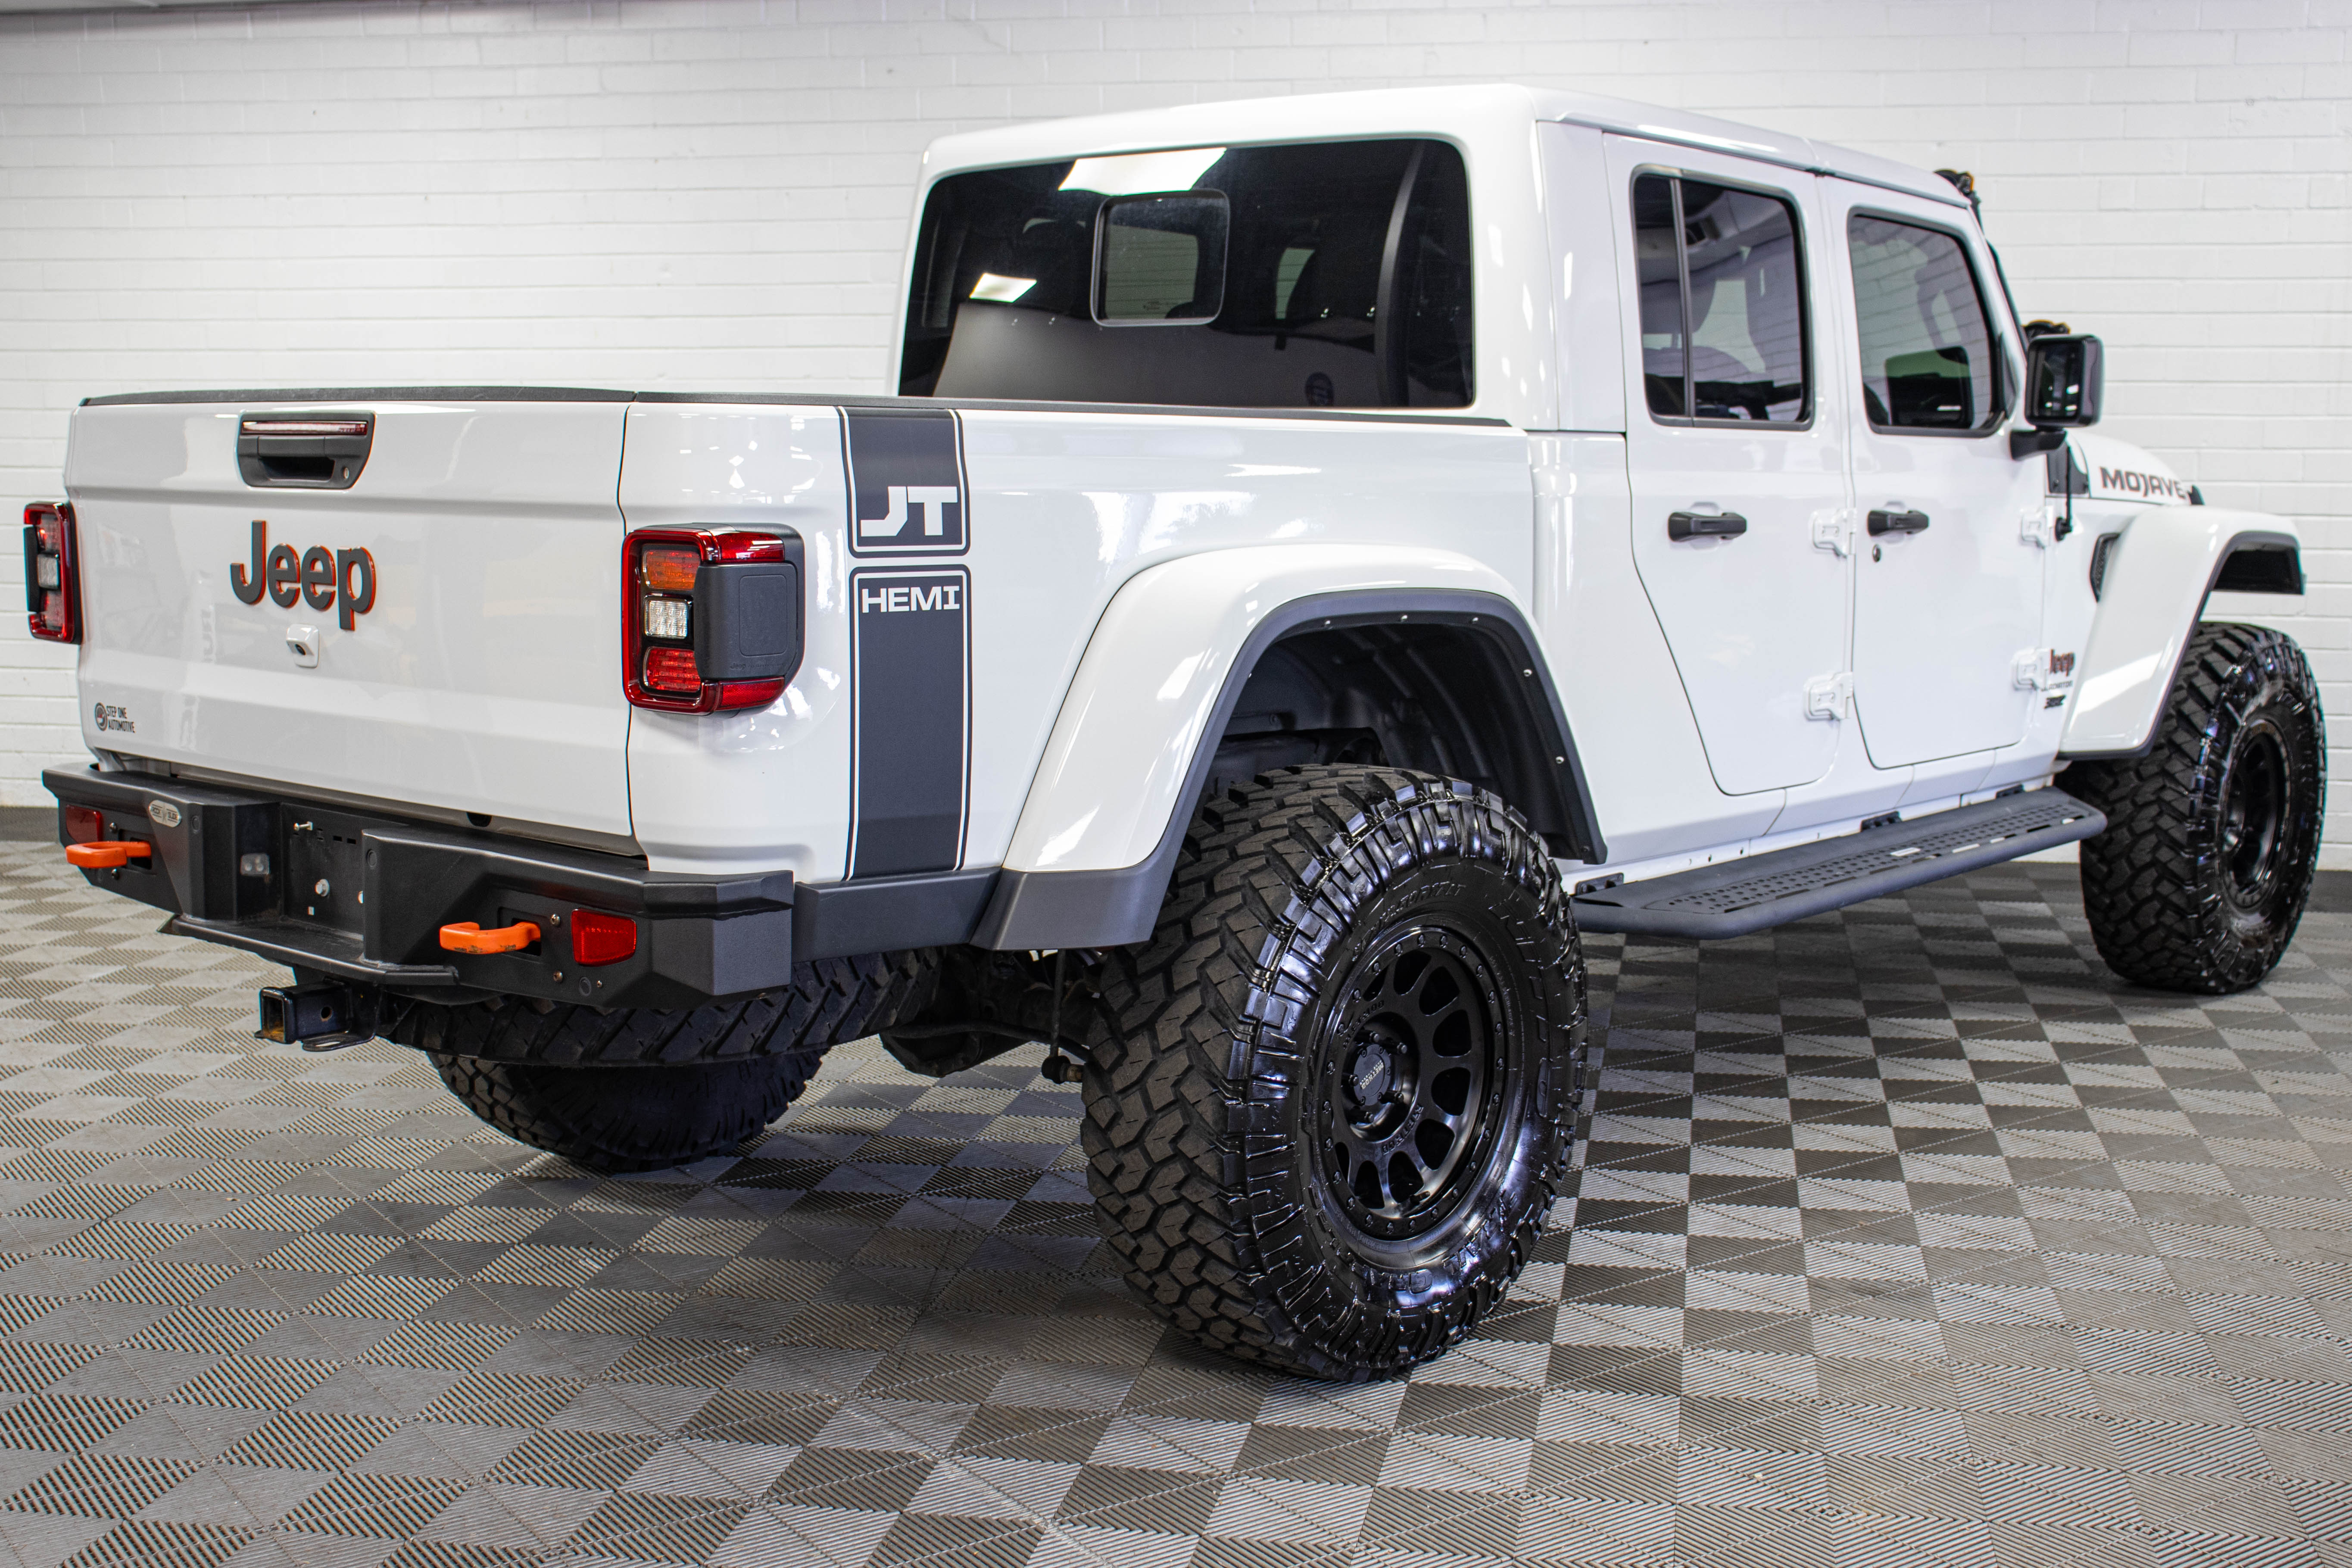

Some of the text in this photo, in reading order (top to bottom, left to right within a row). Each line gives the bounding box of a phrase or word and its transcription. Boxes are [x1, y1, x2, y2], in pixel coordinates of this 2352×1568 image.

[2099, 466, 2186, 499] MOJAVE
[861, 486, 958, 537] JT
[230, 520, 377, 631] Jeep
[862, 586, 960, 613] HEMI
[106, 706, 127, 719] STEP ONE
[108, 719, 135, 733] AUTOMOTIVE
[1360, 1062, 1384, 1090] METHOD
